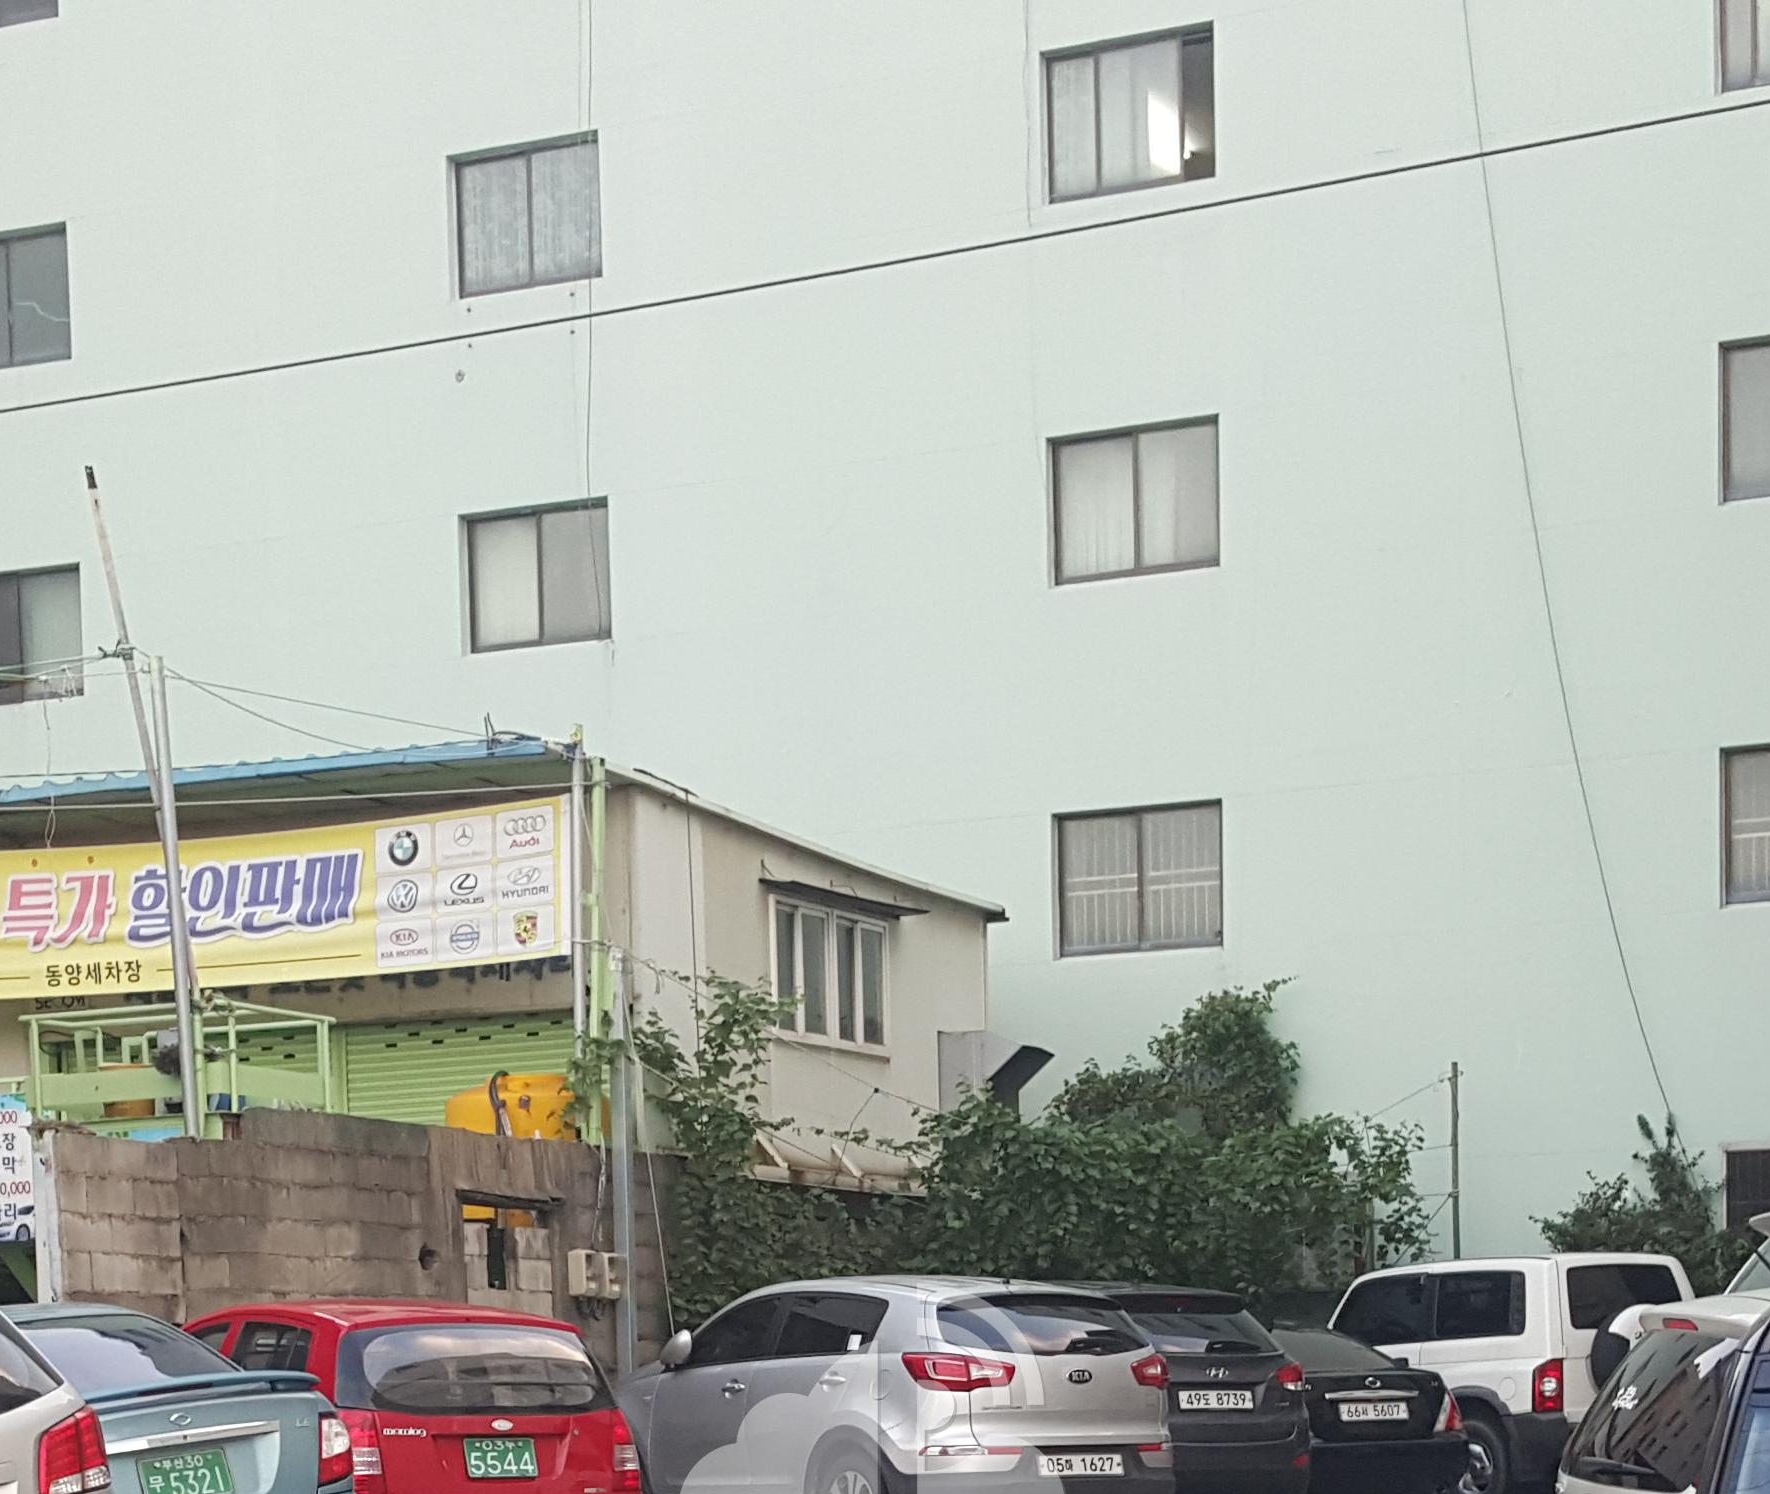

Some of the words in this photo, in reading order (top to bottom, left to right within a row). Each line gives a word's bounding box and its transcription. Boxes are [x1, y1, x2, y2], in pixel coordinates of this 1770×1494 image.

[509, 836, 540, 849] Audi
[1, 871, 115, 947] 특가
[126, 852, 363, 944] 할인판매
[501, 884, 550, 900] HYUNDAI
[444, 896, 485, 906] LEXUS
[45, 961, 143, 988] 동양세차장
[1216, 1392, 1246, 1407] 8739
[1373, 1403, 1401, 1418] 5607
[161, 1454, 204, 1471] 부산30
[470, 1451, 535, 1475] 5544
[1080, 1456, 1114, 1472] 1627
[148, 1475, 166, 1493] 무
